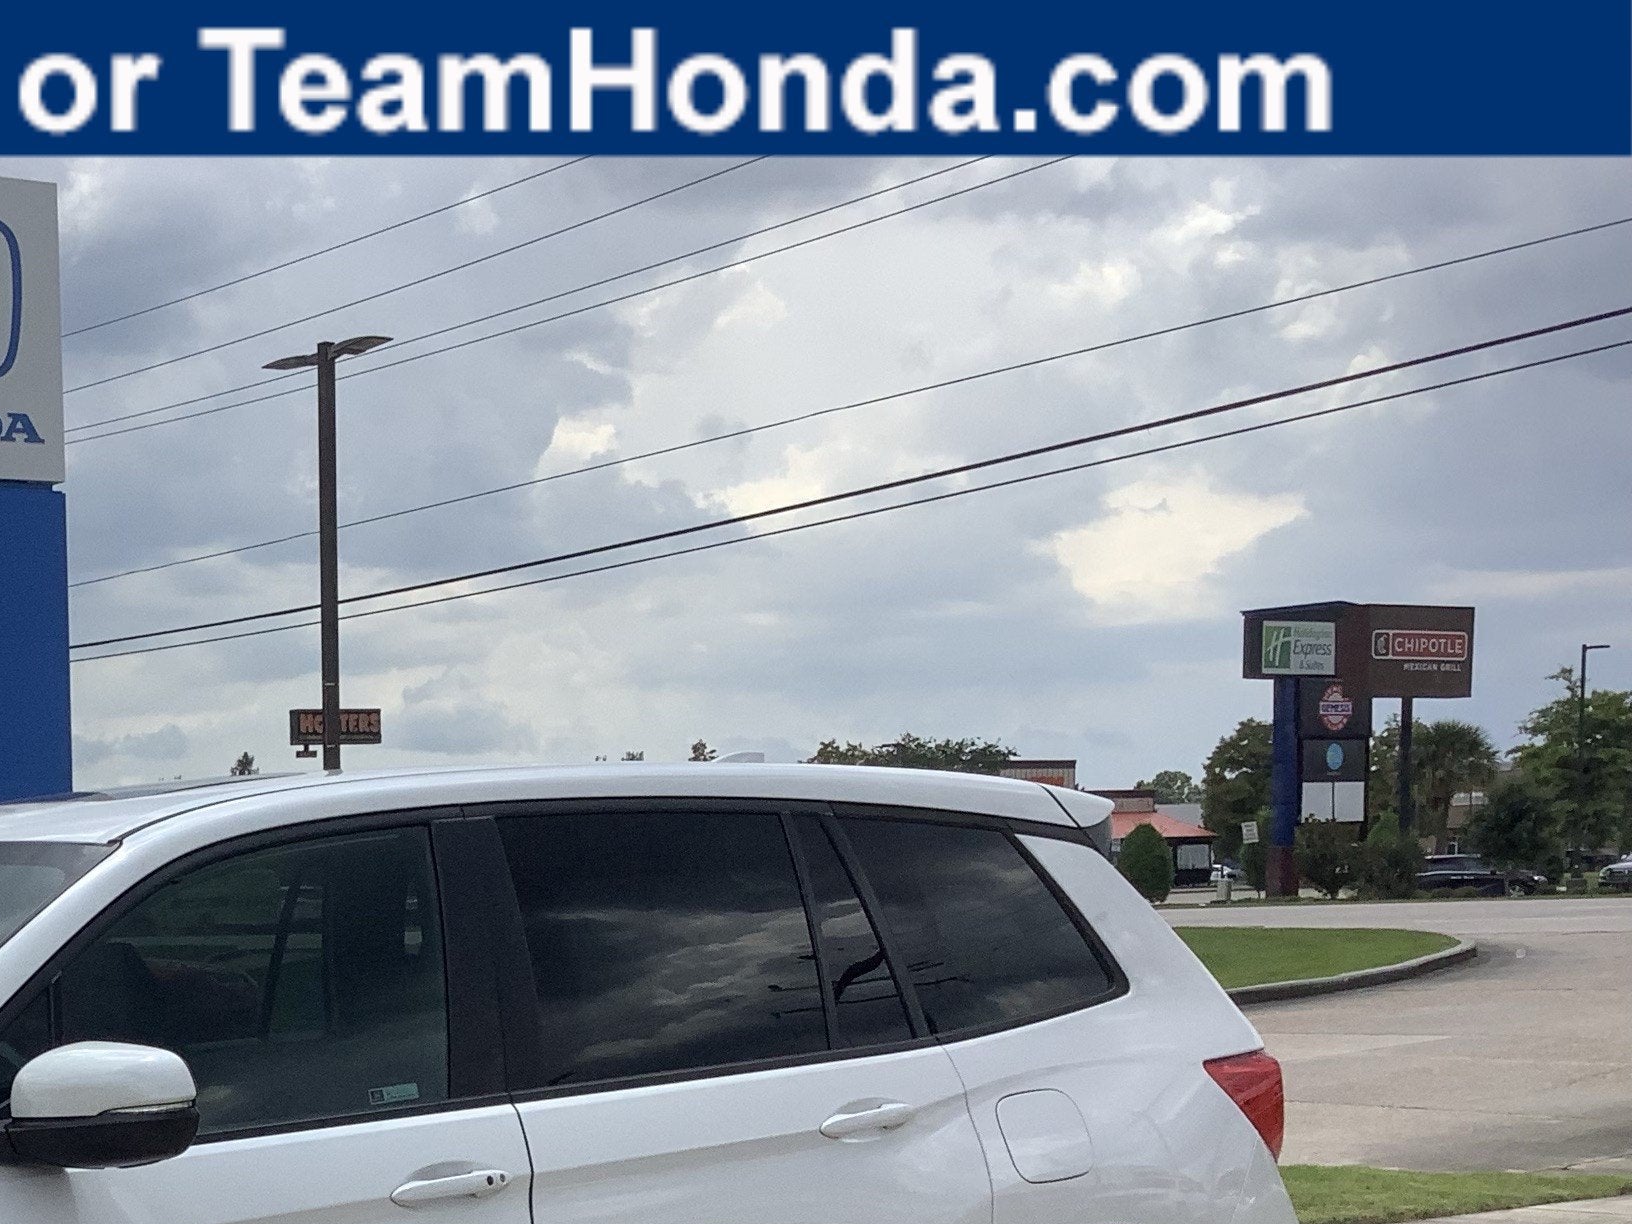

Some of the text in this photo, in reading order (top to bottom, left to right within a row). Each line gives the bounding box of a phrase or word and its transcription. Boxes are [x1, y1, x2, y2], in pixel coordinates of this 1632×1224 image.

[1293, 639, 1332, 660] Express
[1393, 637, 1464, 654] CHIPOTLE
[1403, 662, 1438, 672] MEXICAN
[299, 712, 379, 735] HOTERS
